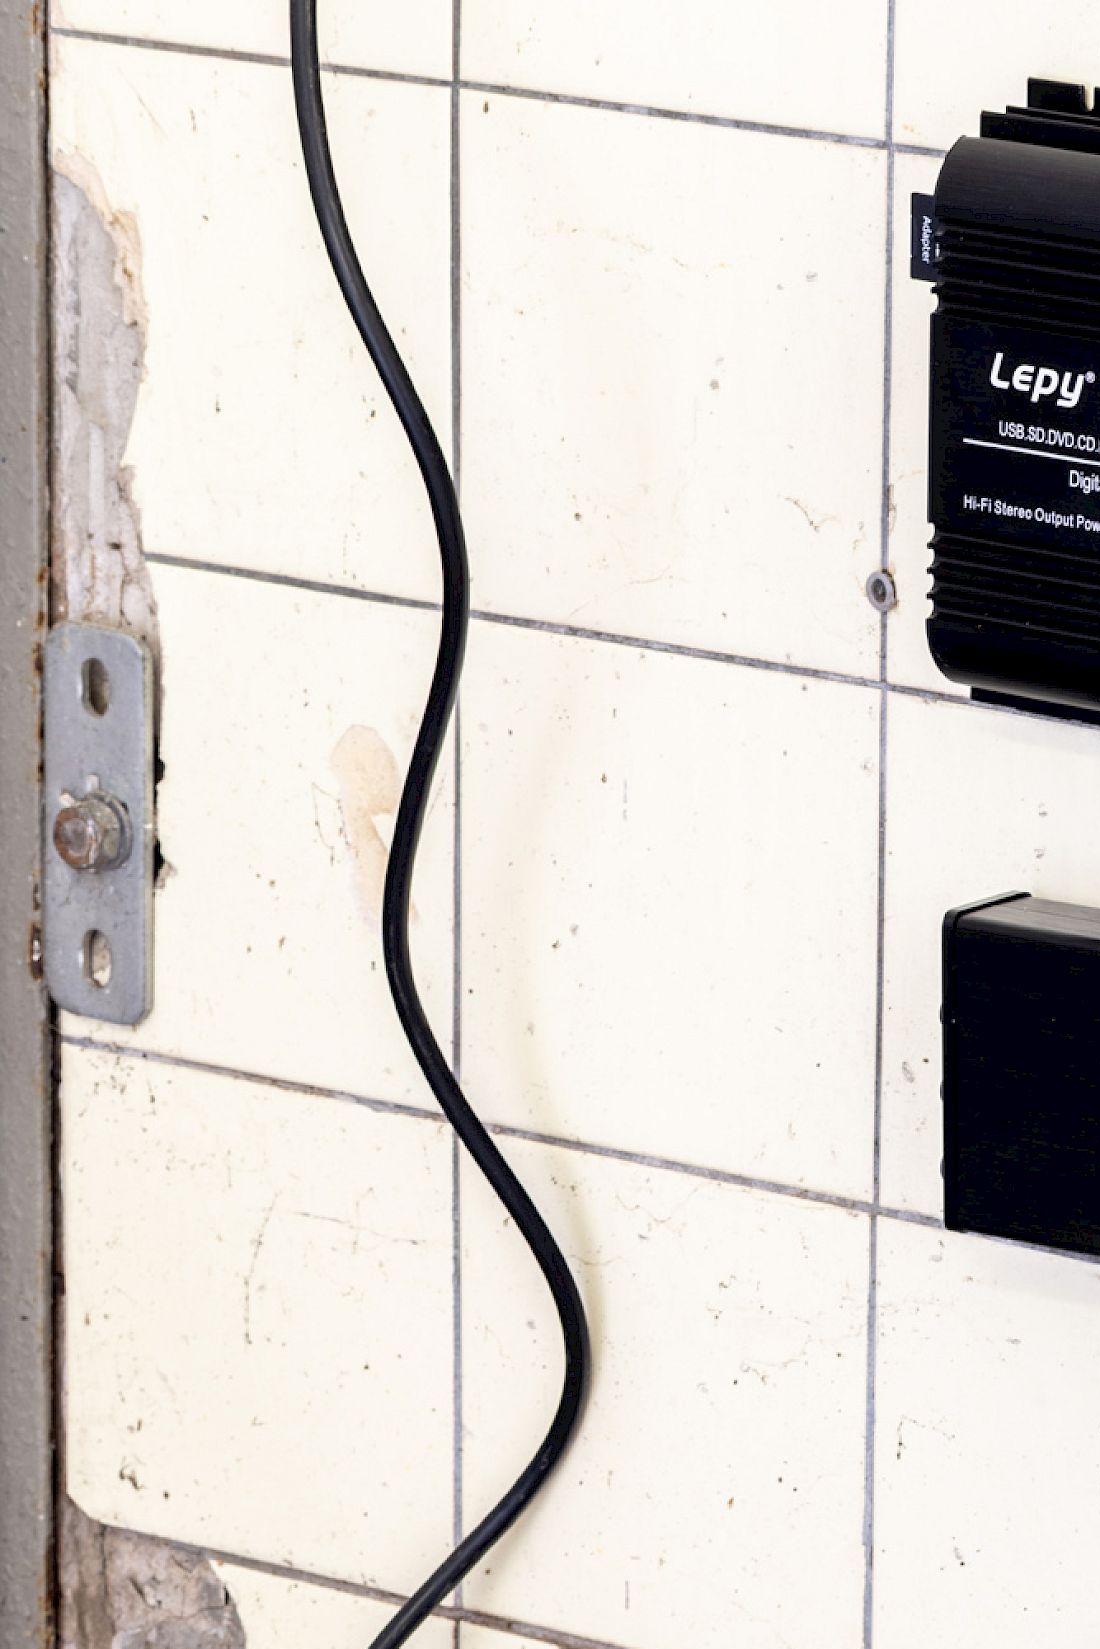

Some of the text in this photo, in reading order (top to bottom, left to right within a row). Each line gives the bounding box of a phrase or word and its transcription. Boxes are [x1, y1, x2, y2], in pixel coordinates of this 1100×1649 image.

[919, 215, 933, 264] Adapter
[962, 493, 993, 513] Hi-Fi
[993, 500, 1033, 521] Stereo
[1034, 507, 1075, 529] Output
